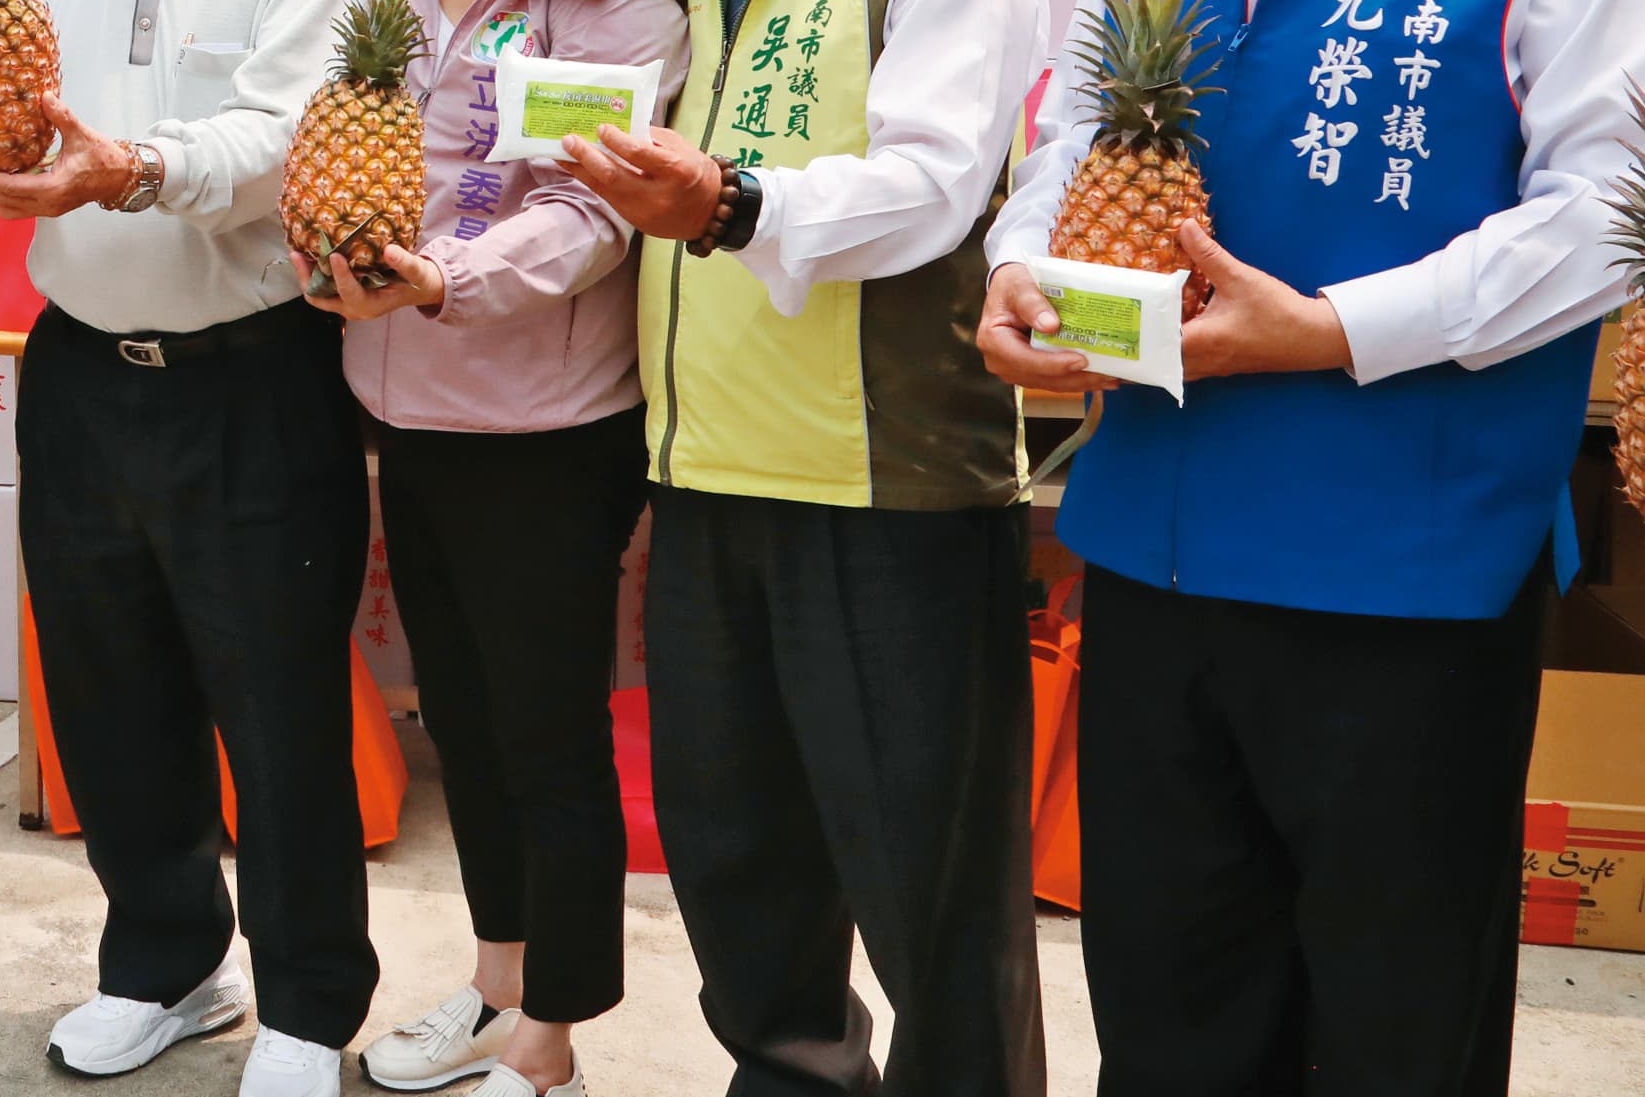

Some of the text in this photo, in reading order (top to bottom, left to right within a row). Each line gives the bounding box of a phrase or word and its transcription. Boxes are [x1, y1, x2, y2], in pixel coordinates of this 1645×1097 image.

[366, 537, 391, 648] 香甜美味
[1522, 850, 1616, 884] lk Soft
